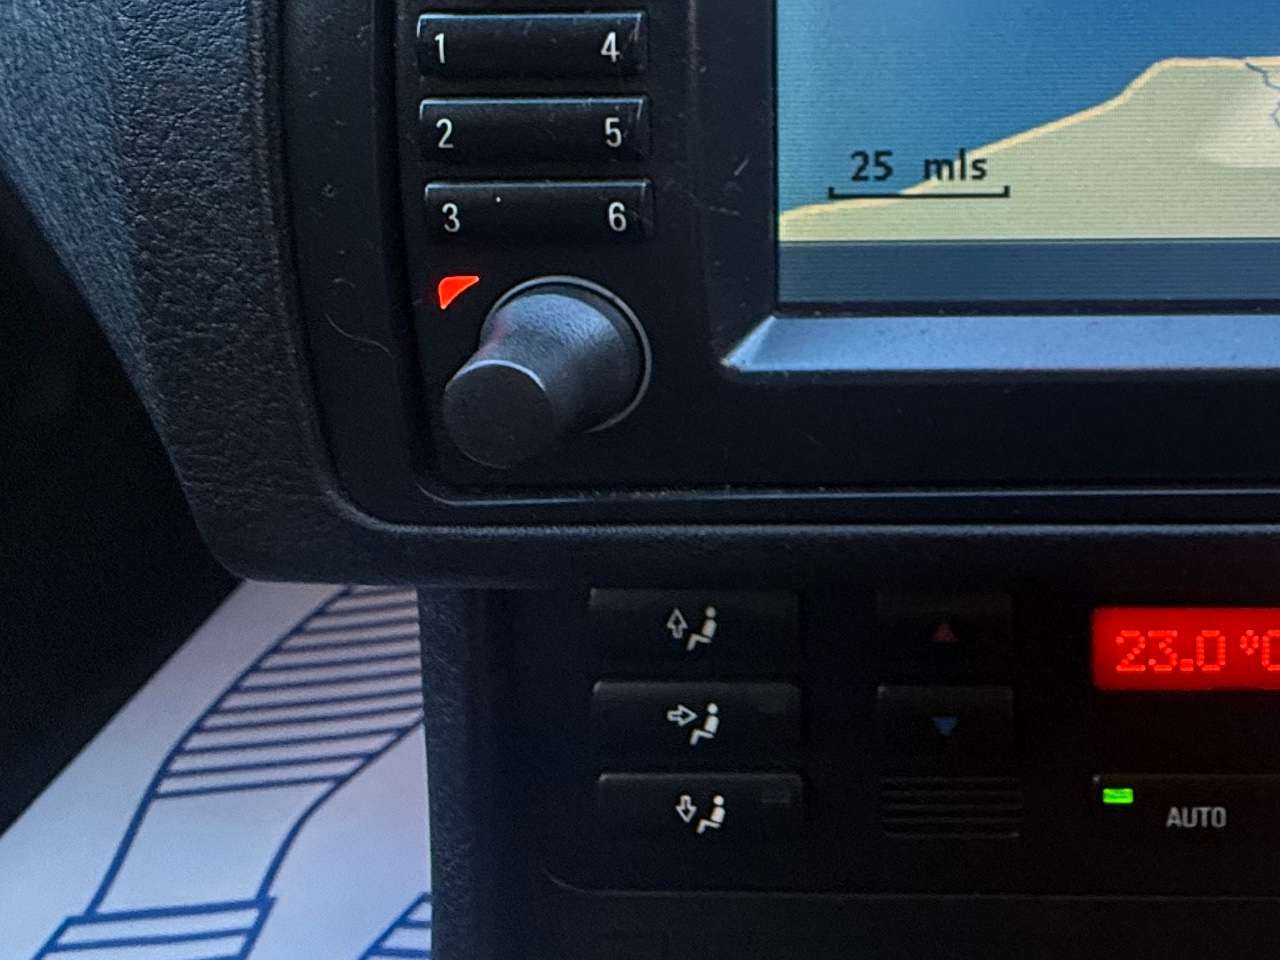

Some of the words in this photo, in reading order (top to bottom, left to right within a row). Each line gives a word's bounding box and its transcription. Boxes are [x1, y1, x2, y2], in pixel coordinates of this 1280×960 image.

[434, 33, 446, 64] 1
[600, 31, 620, 63] 4
[435, 118, 454, 148] 2
[604, 117, 622, 147] 5
[851, 150, 894, 182] 25
[923, 148, 988, 181] mls
[441, 203, 461, 232] 3
[607, 201, 627, 231] 6
[1116, 630, 1226, 672] 23.0
[1166, 806, 1227, 828] AUTO
